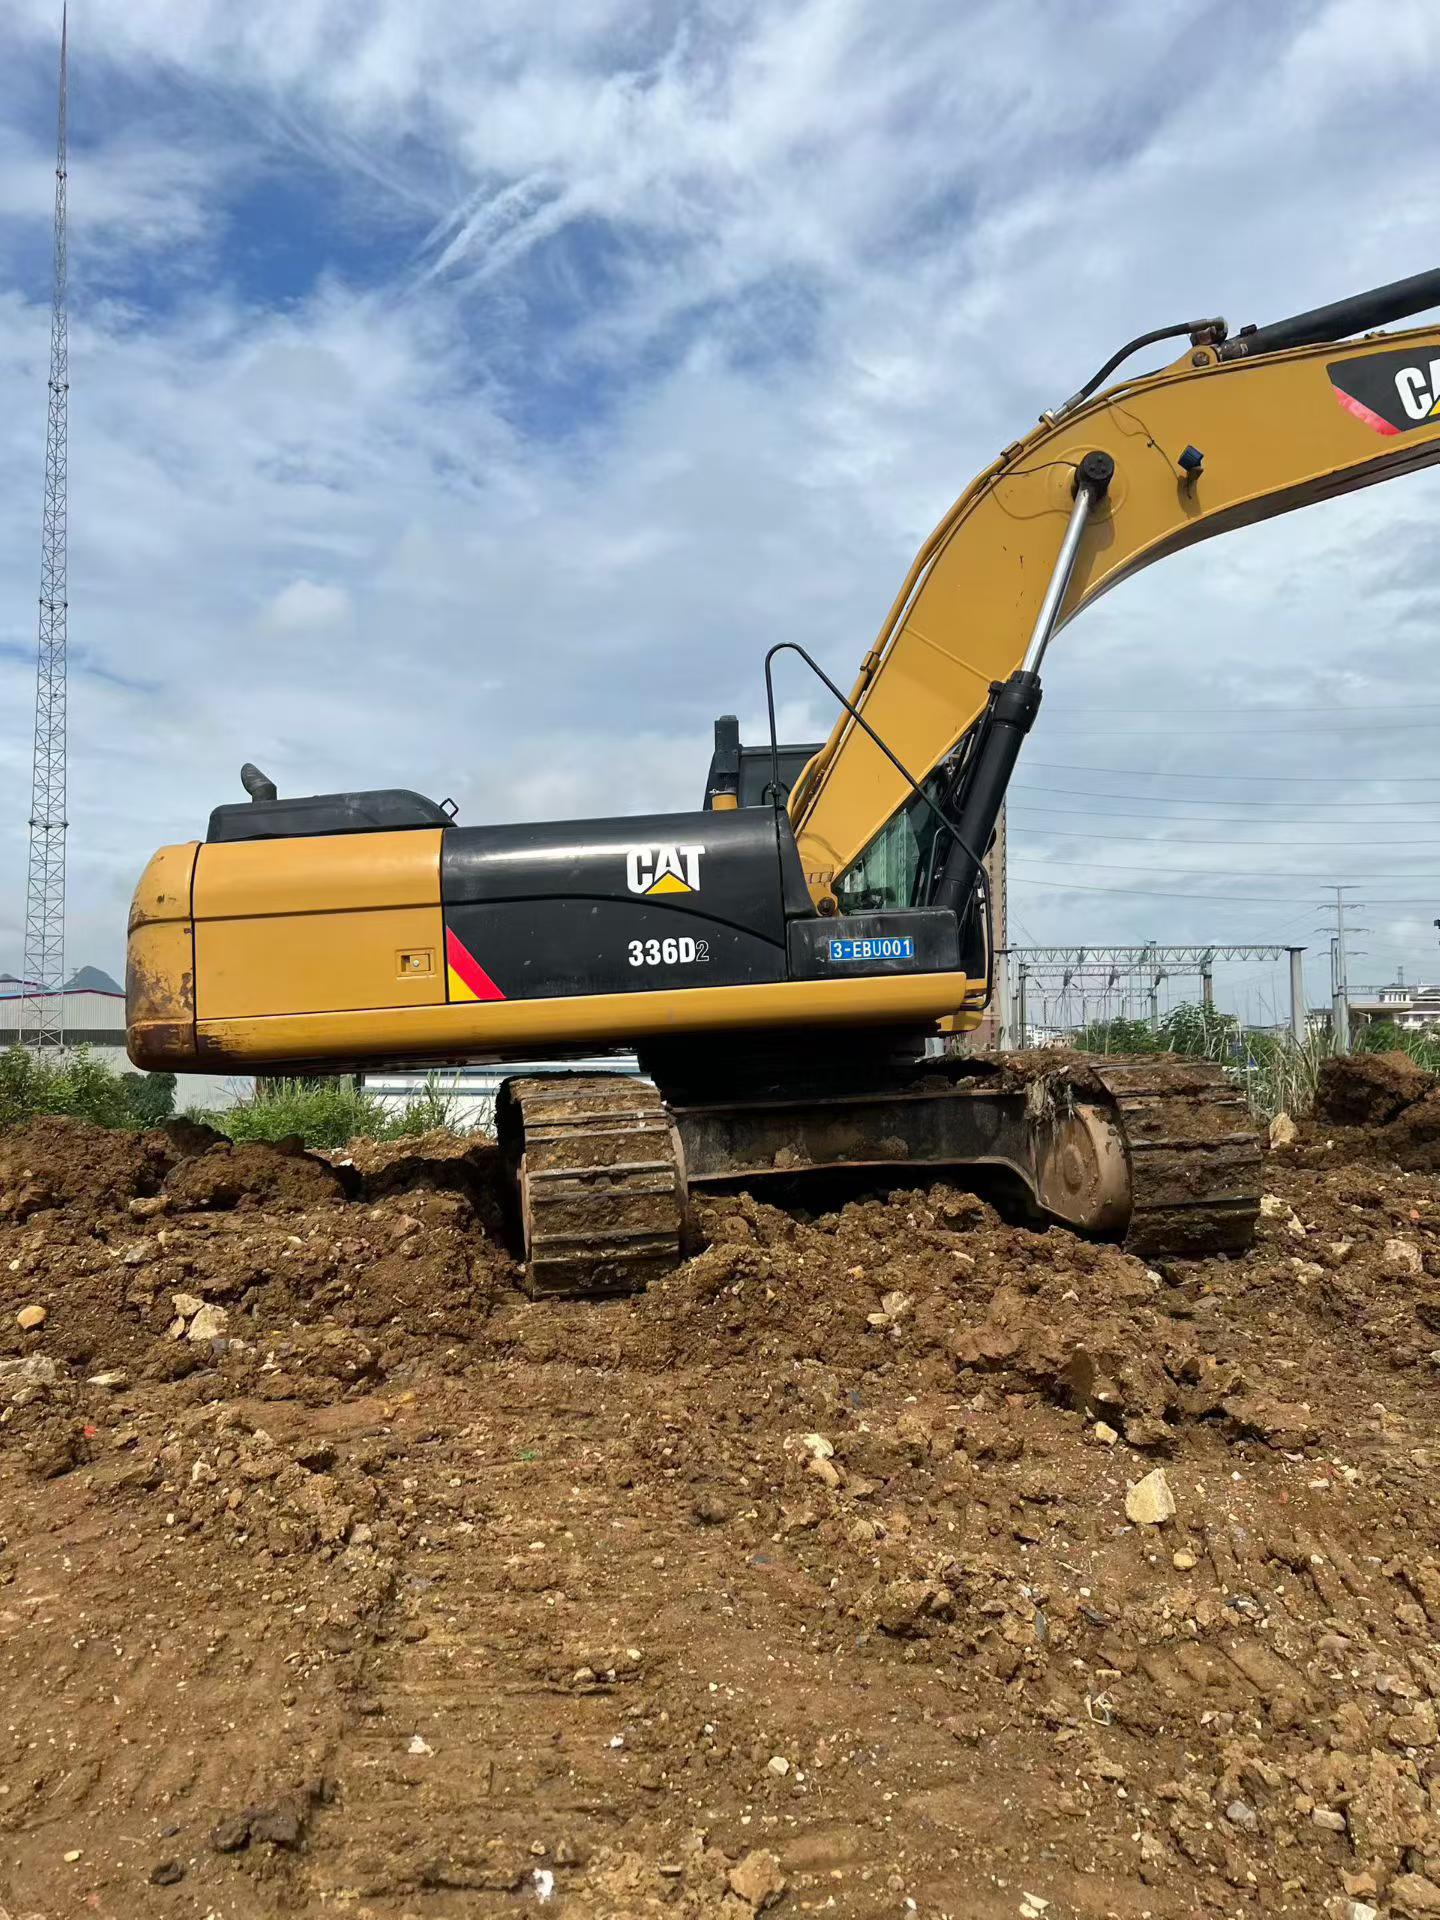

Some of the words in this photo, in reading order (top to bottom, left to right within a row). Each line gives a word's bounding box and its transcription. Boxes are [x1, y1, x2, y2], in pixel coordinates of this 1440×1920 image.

[626, 845, 706, 894] CAT
[628, 937, 710, 967] 336D2
[833, 939, 911, 959] 3-EBU001
